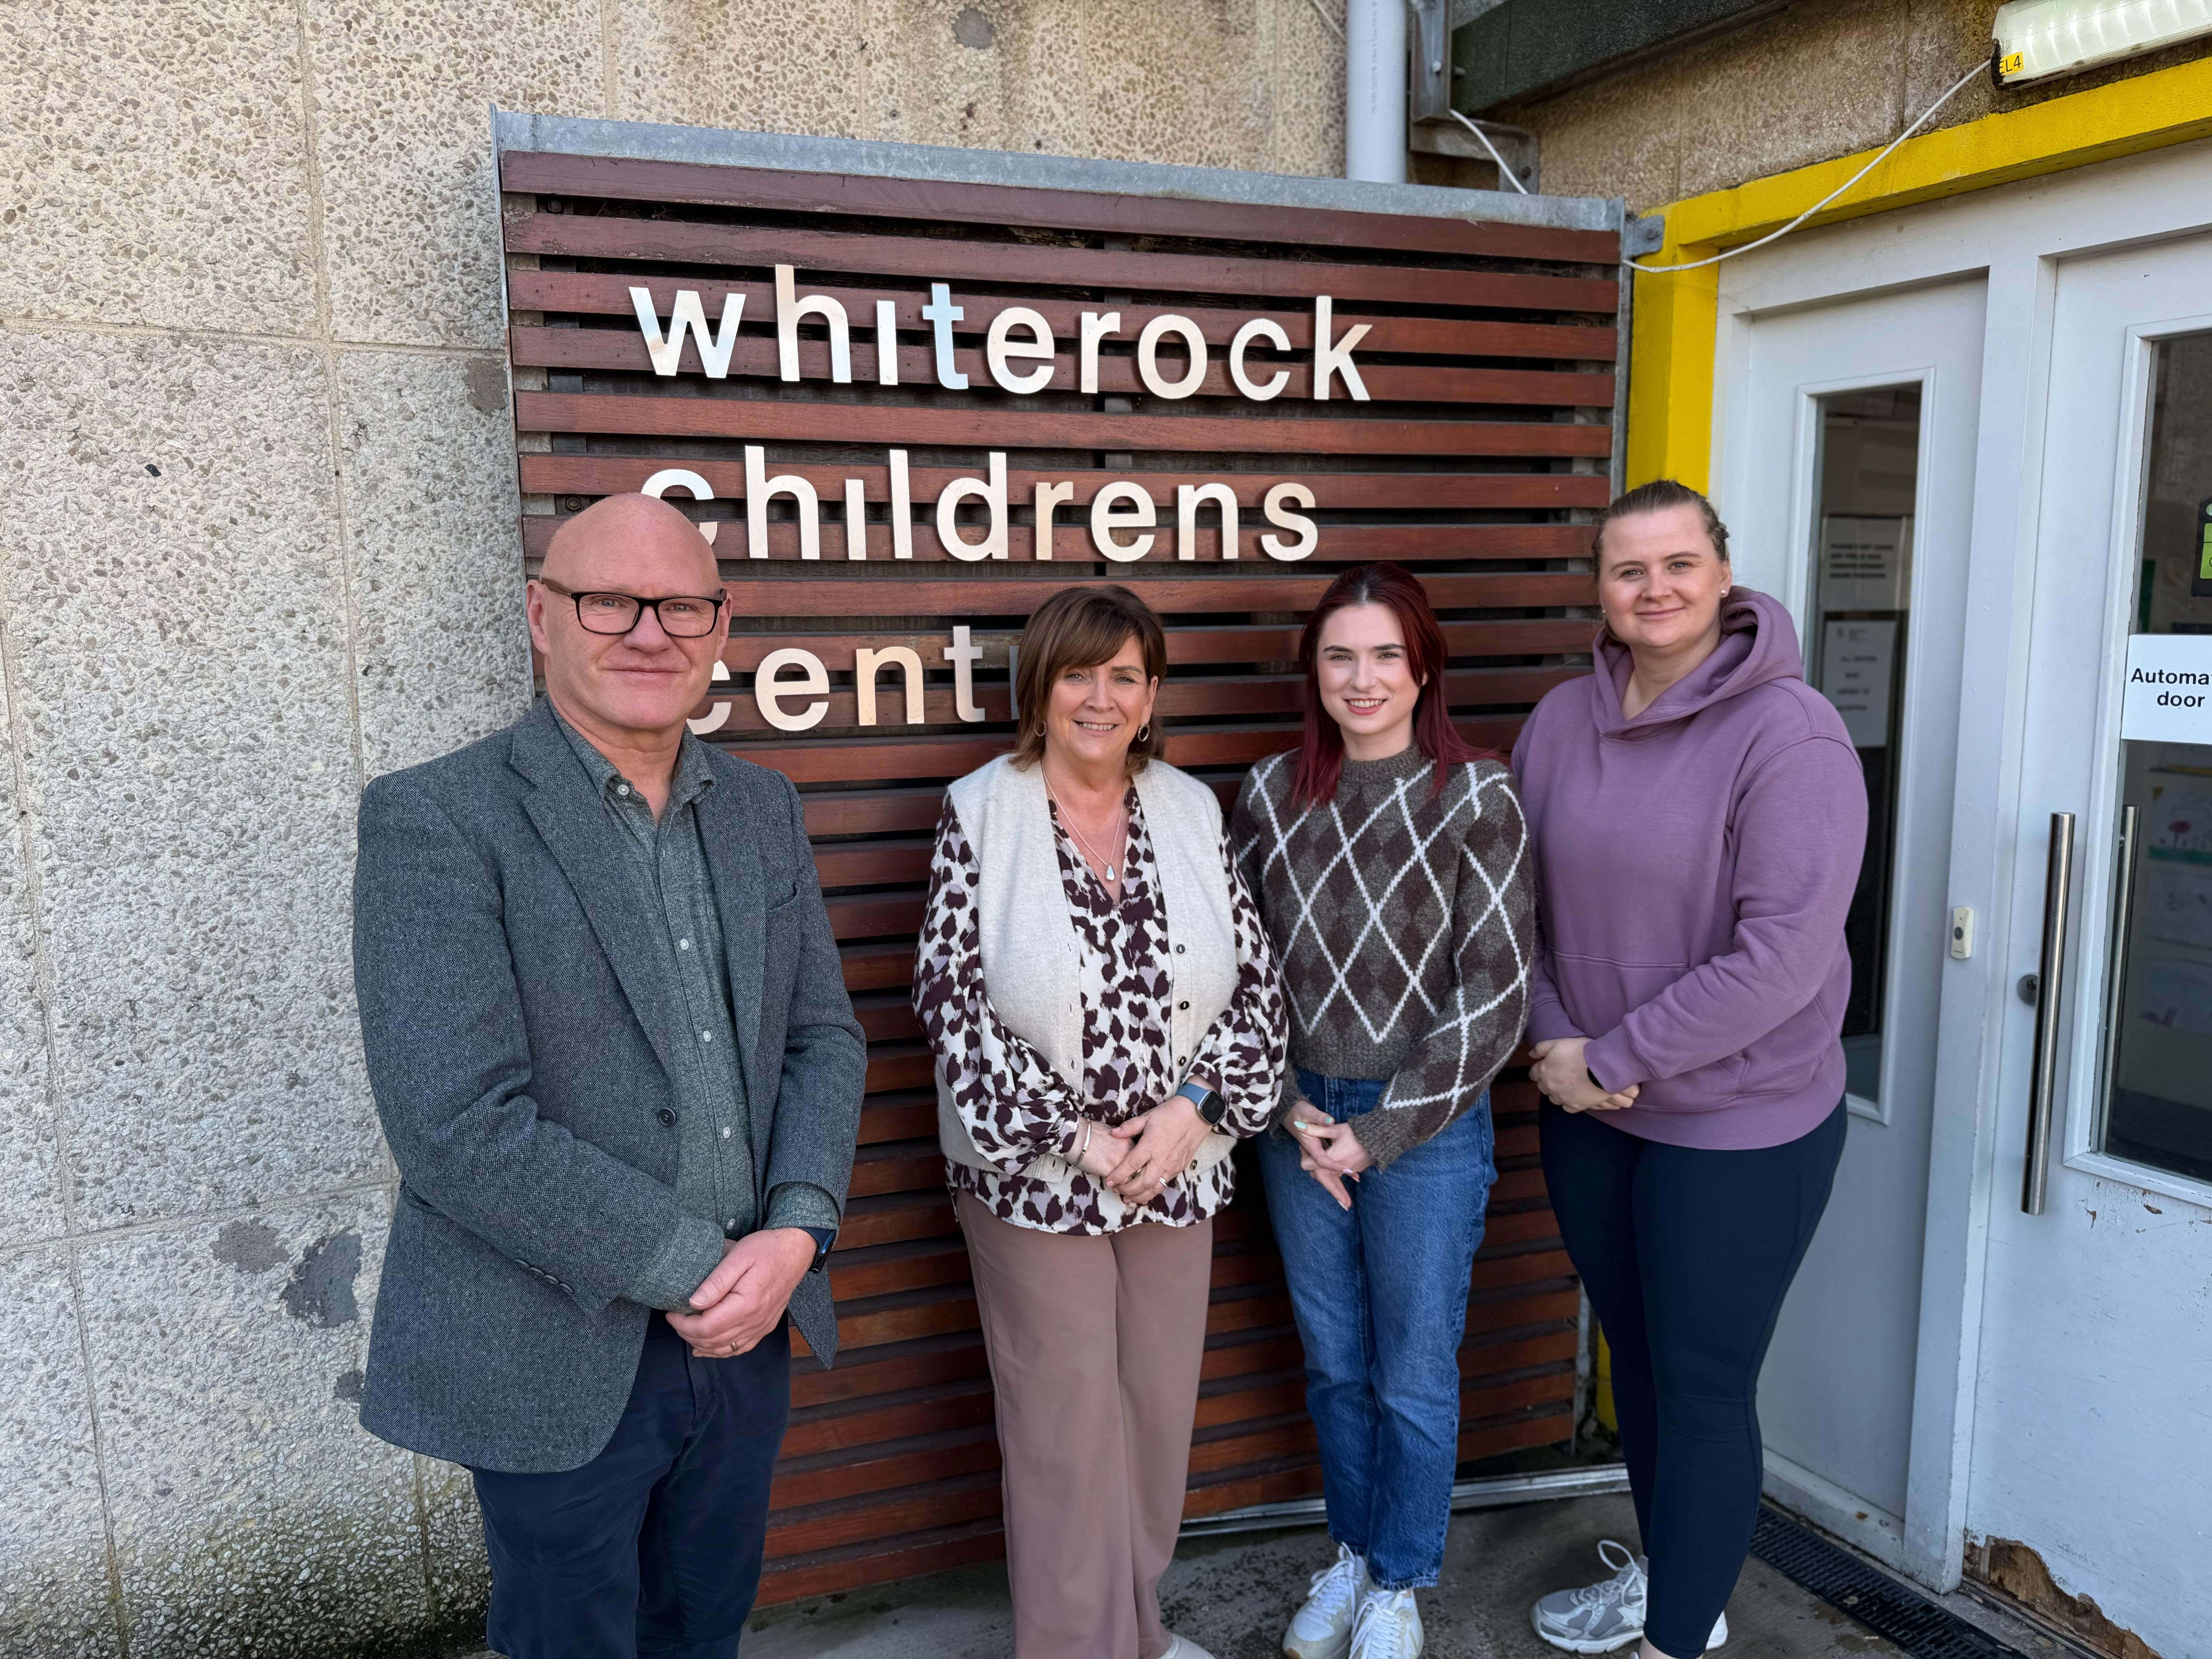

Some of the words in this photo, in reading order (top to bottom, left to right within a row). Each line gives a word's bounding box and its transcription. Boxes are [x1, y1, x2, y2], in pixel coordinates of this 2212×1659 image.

[1999, 55, 2022, 74] EL4
[629, 264, 1372, 401] whiterock
[687, 625, 1019, 735] ent
[2131, 668, 2212, 685] Automa
[2157, 691, 2205, 707] door
